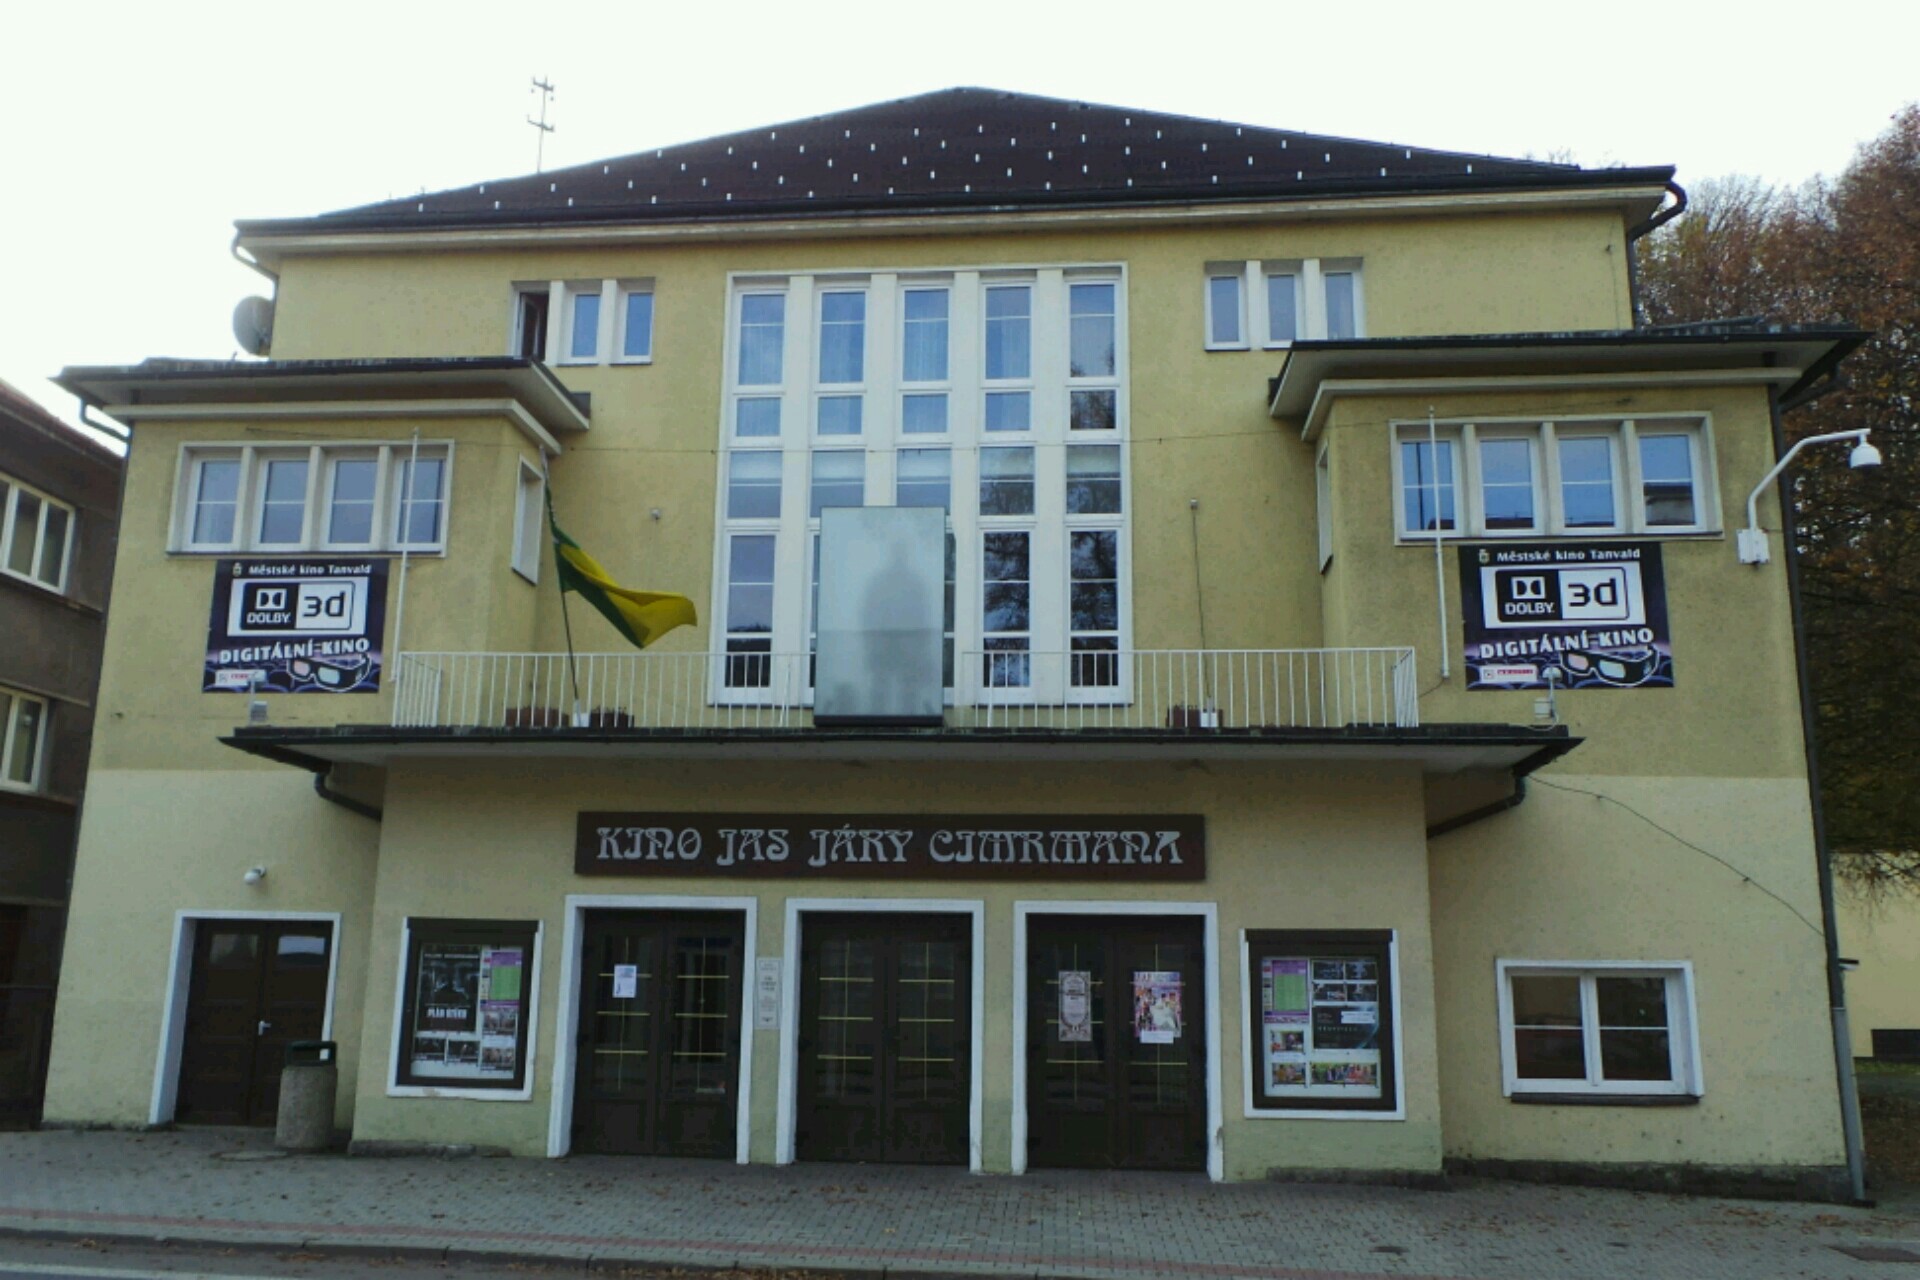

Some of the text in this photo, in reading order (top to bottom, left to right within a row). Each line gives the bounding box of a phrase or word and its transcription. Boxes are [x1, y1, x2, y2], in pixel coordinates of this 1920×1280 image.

[1497, 548, 1640, 562] Městské kino Tanvald
[300, 564, 324, 574] kino
[1505, 602, 1554, 615] DOLBY
[246, 612, 291, 624] DOLBY
[596, 824, 1184, 867] KINO JAS JÁRY CIMRMANA
